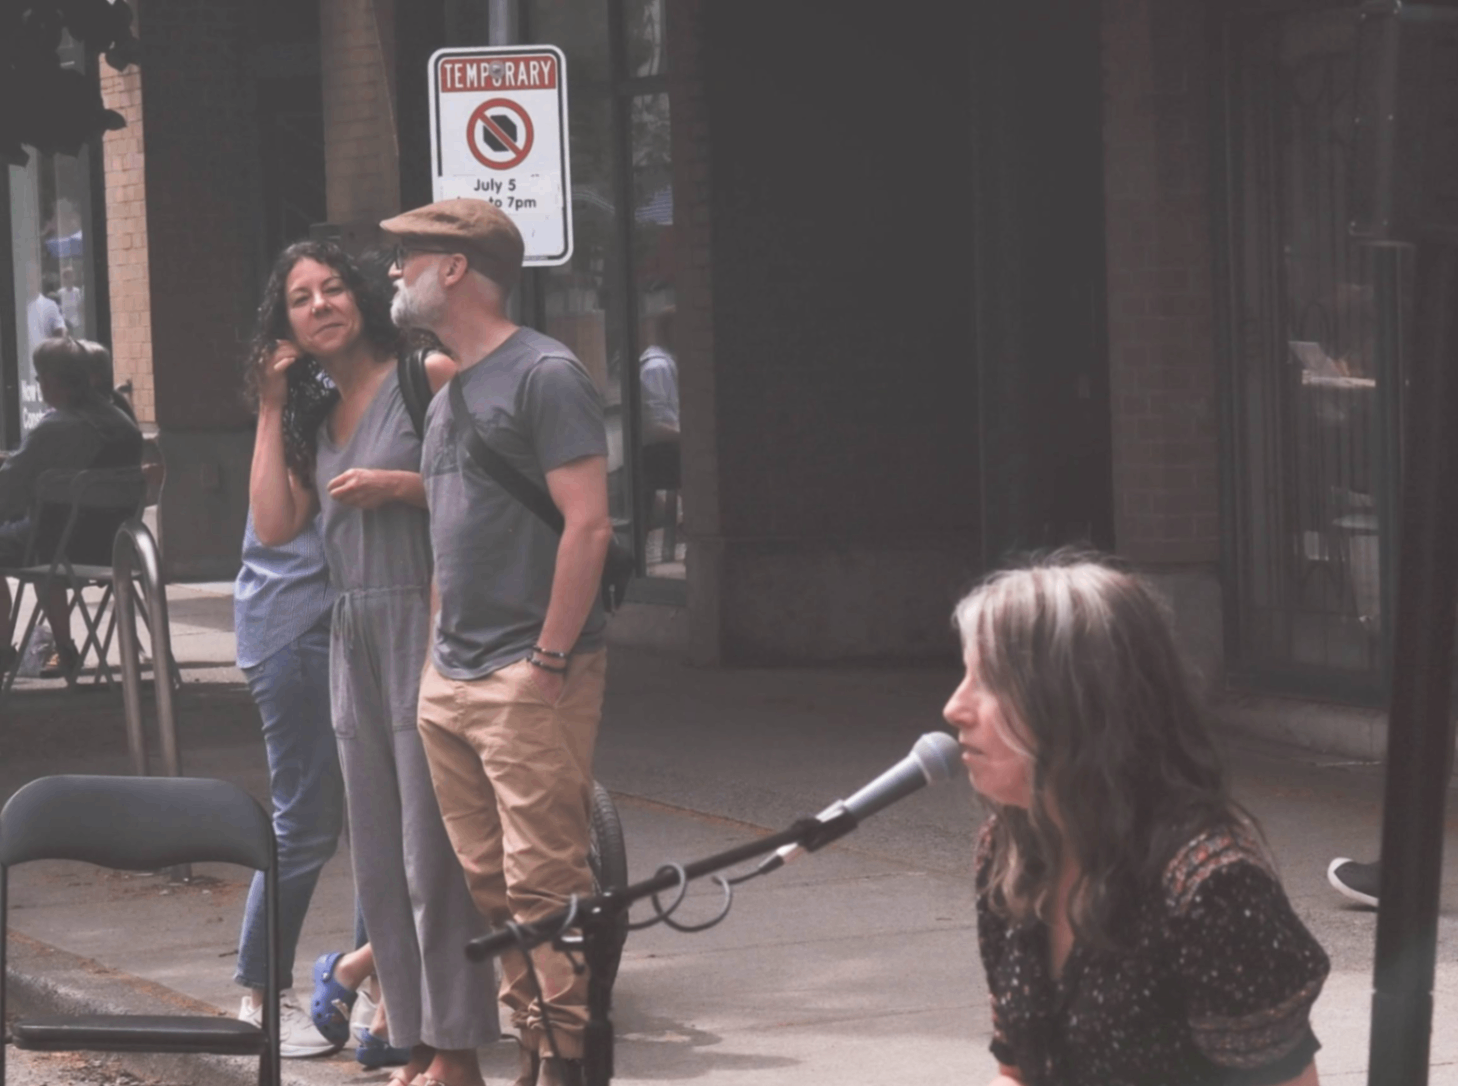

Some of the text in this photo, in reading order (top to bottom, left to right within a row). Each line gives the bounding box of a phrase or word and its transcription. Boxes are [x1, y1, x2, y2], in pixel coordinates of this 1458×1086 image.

[473, 178, 517, 195] July 5
[507, 196, 537, 211] 7pm
